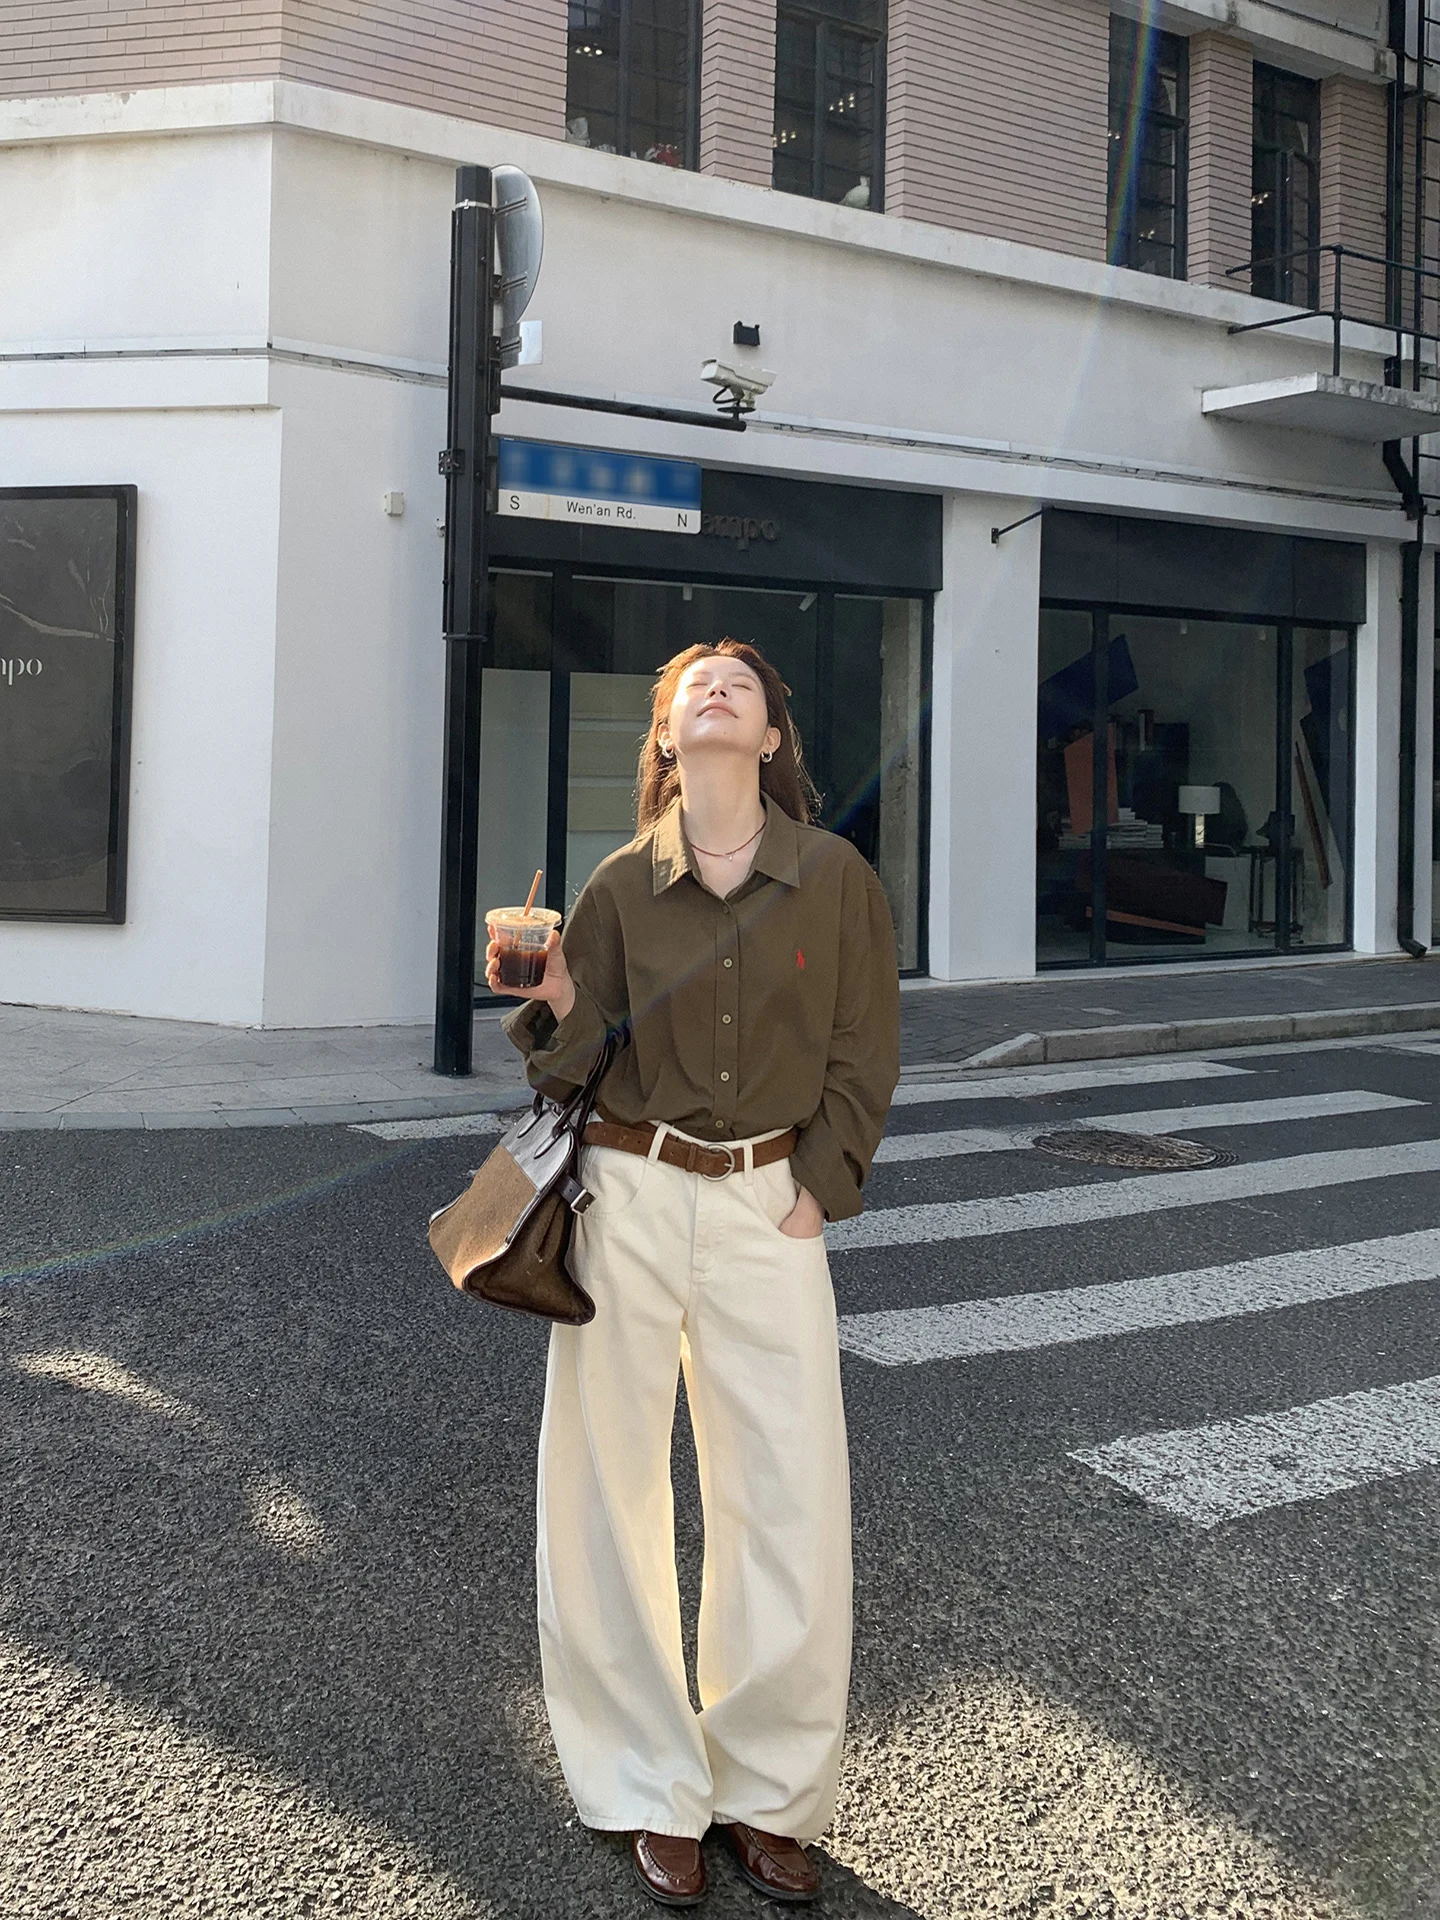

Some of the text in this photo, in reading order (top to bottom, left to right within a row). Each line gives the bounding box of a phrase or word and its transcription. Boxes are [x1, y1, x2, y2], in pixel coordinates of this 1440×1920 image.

[510, 495, 688, 528] S Wen'an Rd. N
